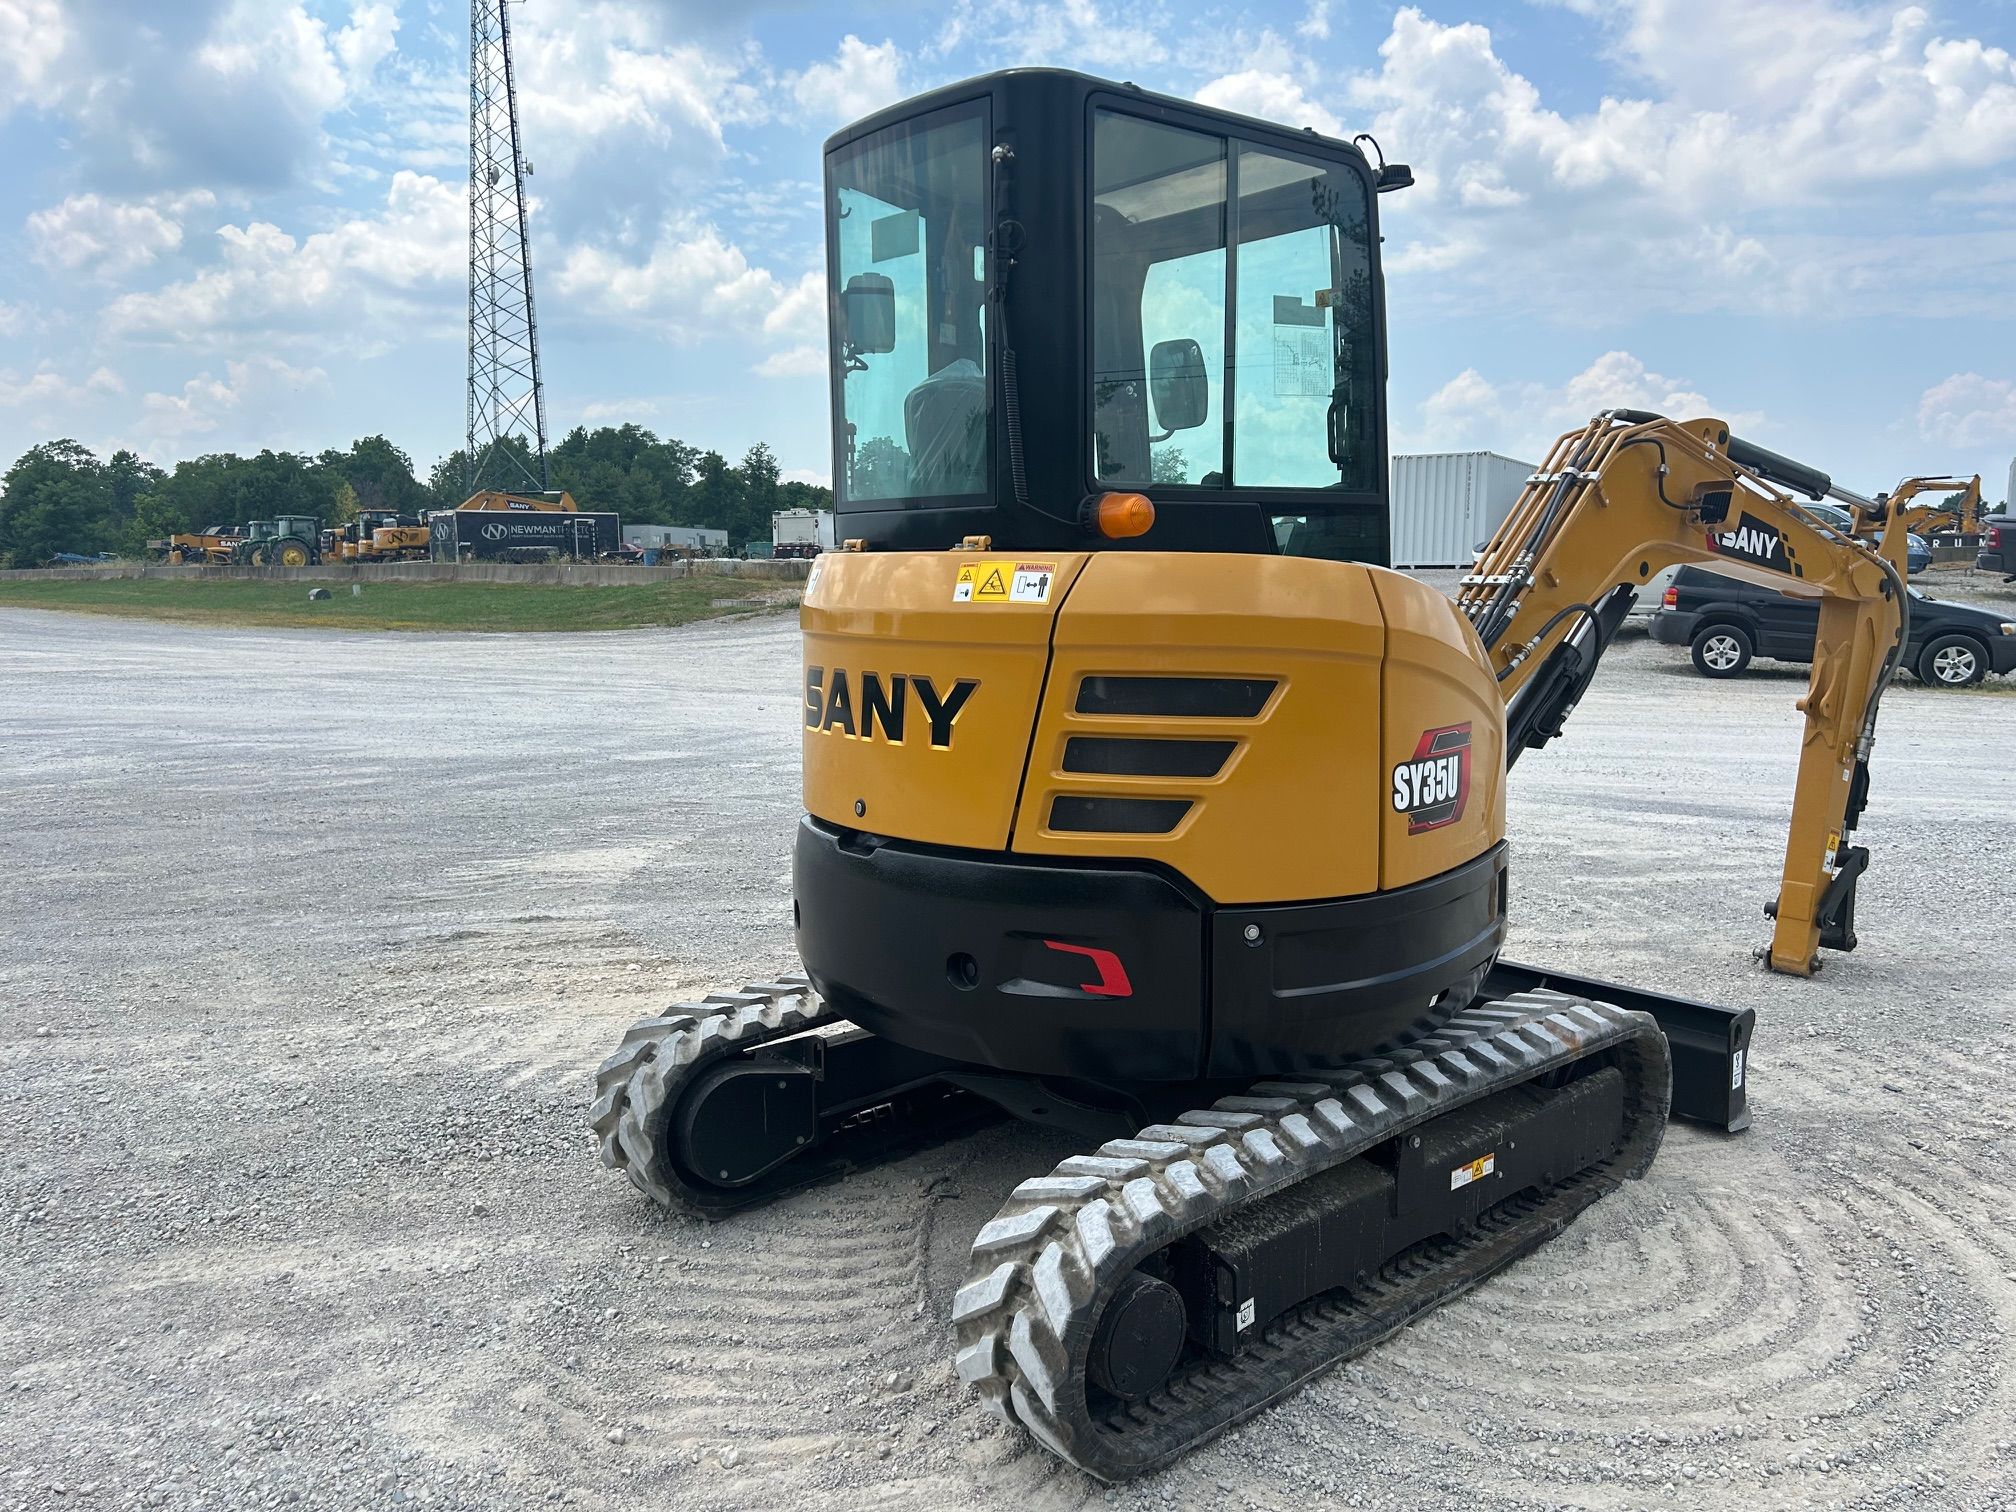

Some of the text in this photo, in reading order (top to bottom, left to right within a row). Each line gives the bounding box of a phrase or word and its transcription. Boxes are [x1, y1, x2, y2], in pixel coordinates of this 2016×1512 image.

[1722, 526, 1778, 559] SANY
[805, 665, 982, 751] SANY
[1393, 755, 1459, 811] SY35U
